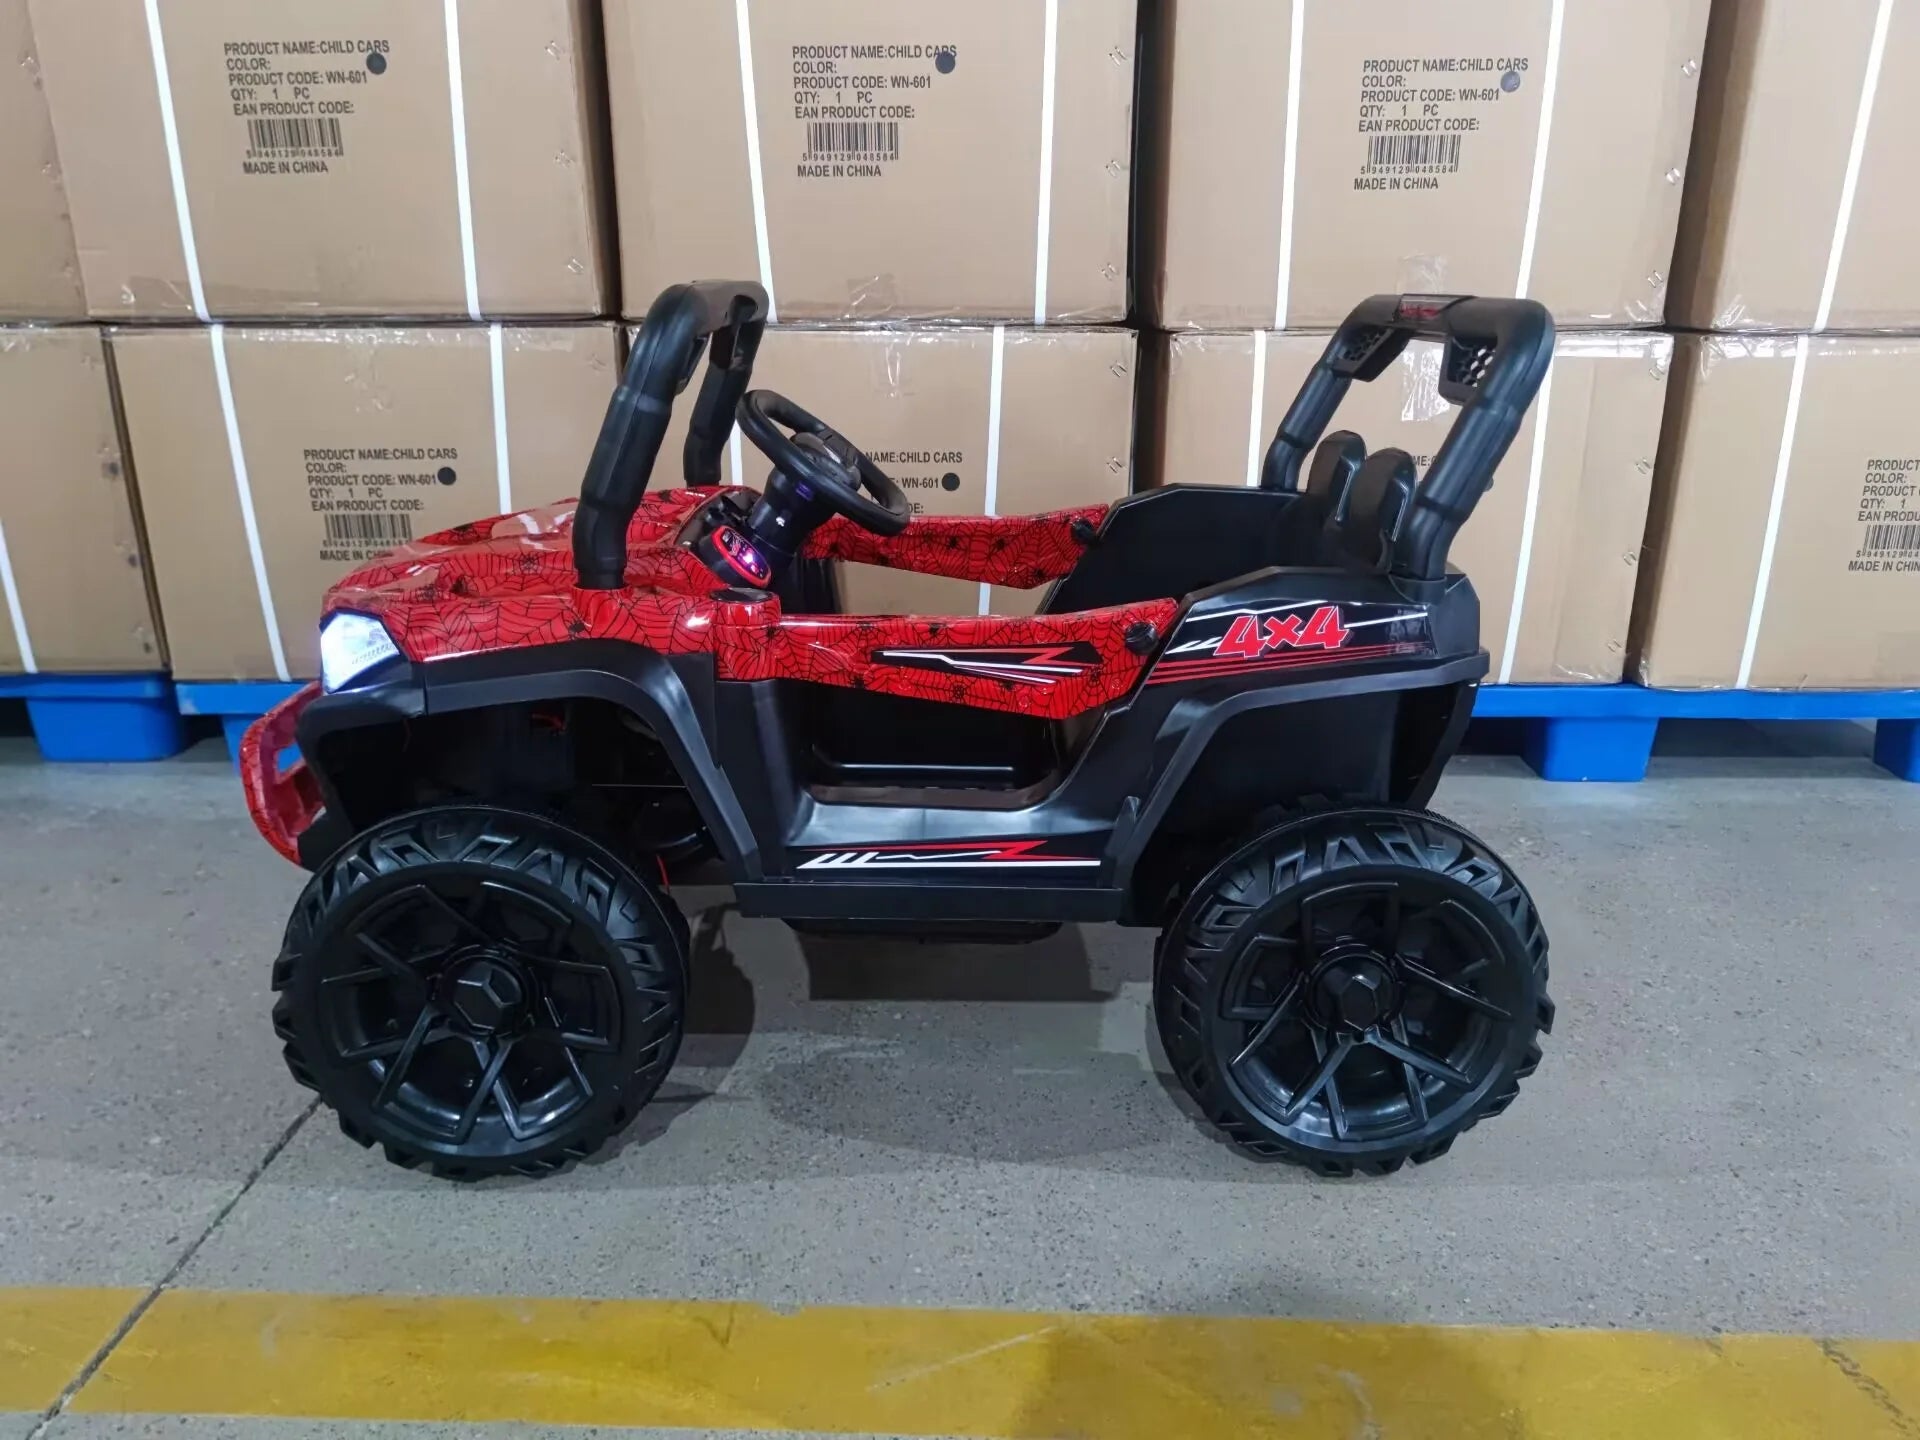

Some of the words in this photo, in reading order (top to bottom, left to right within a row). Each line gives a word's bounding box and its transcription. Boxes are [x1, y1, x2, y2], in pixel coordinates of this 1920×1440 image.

[224, 42, 279, 56] PRODUCT
[357, 39, 390, 53] CARS
[792, 46, 848, 58] PRODUCT
[226, 58, 271, 71] COLOR:
[793, 61, 837, 74] COLOR:
[1363, 59, 1420, 73] PRODUCT
[1497, 57, 1529, 72] CARS
[229, 72, 284, 86] PRODUCT
[287, 71, 324, 85] CODE:
[326, 70, 367, 84] WN-601
[793, 76, 848, 89] PRODUCT
[852, 76, 888, 89] CODE:
[891, 76, 931, 89] WN-601
[1362, 75, 1407, 87] COLOR:
[231, 88, 257, 101] QTY:
[272, 87, 279, 100] 1
[293, 87, 310, 99] PC
[794, 91, 820, 105] QTY:
[835, 91, 841, 103] 1
[857, 91, 873, 104] PC
[1360, 89, 1417, 103] PRODUCT
[1420, 88, 1456, 102] CODE:
[1459, 88, 1500, 101] WN-601
[234, 103, 257, 116] EAN
[260, 101, 314, 115] PRODUCT
[318, 101, 355, 114] CODE:
[795, 106, 818, 119] EAN
[821, 106, 876, 119] PRODUCT
[879, 105, 915, 118] CODE:
[1359, 105, 1386, 118] QTY:
[1401, 104, 1407, 116] 1
[1423, 104, 1439, 116] PC
[1358, 119, 1382, 132] EAN
[1385, 118, 1441, 131] PRODUCT
[1444, 118, 1480, 131] CODE:
[243, 161, 276, 174] MADE
[279, 161, 290, 174] IN
[292, 160, 329, 174] CHINA
[797, 164, 830, 177] MADE
[833, 164, 844, 177] IN
[847, 164, 882, 177] CHINA
[1354, 178, 1387, 190] MADE
[1389, 177, 1401, 190] IN
[1403, 177, 1439, 190] CHINA
[303, 449, 355, 460] PRODUCT
[428, 448, 457, 459] CARS
[933, 451, 963, 464] CARS
[305, 463, 347, 473] COLOR:
[1867, 459, 1920, 471] PRODUCT
[308, 475, 358, 486] PRODUCT
[362, 474, 396, 485] CODE:
[398, 474, 436, 485] WN-601
[901, 477, 939, 489] WN-601
[1865, 472, 1908, 484] COLOR:
[309, 488, 334, 499] QTY:
[348, 488, 354, 498] 1
[368, 487, 383, 498] PC
[1862, 485, 1917, 497] PRODUCT
[312, 501, 334, 511] EAN
[336, 500, 387, 511] PRODUCT
[390, 499, 424, 510] CODE:
[1860, 498, 1885, 509] QTY:
[1900, 498, 1906, 509] 1
[1857, 510, 1881, 522] EAN
[320, 550, 350, 560] MADE
[352, 550, 363, 560] IN
[1848, 560, 1880, 571] MADE
[1882, 560, 1893, 571] IN
